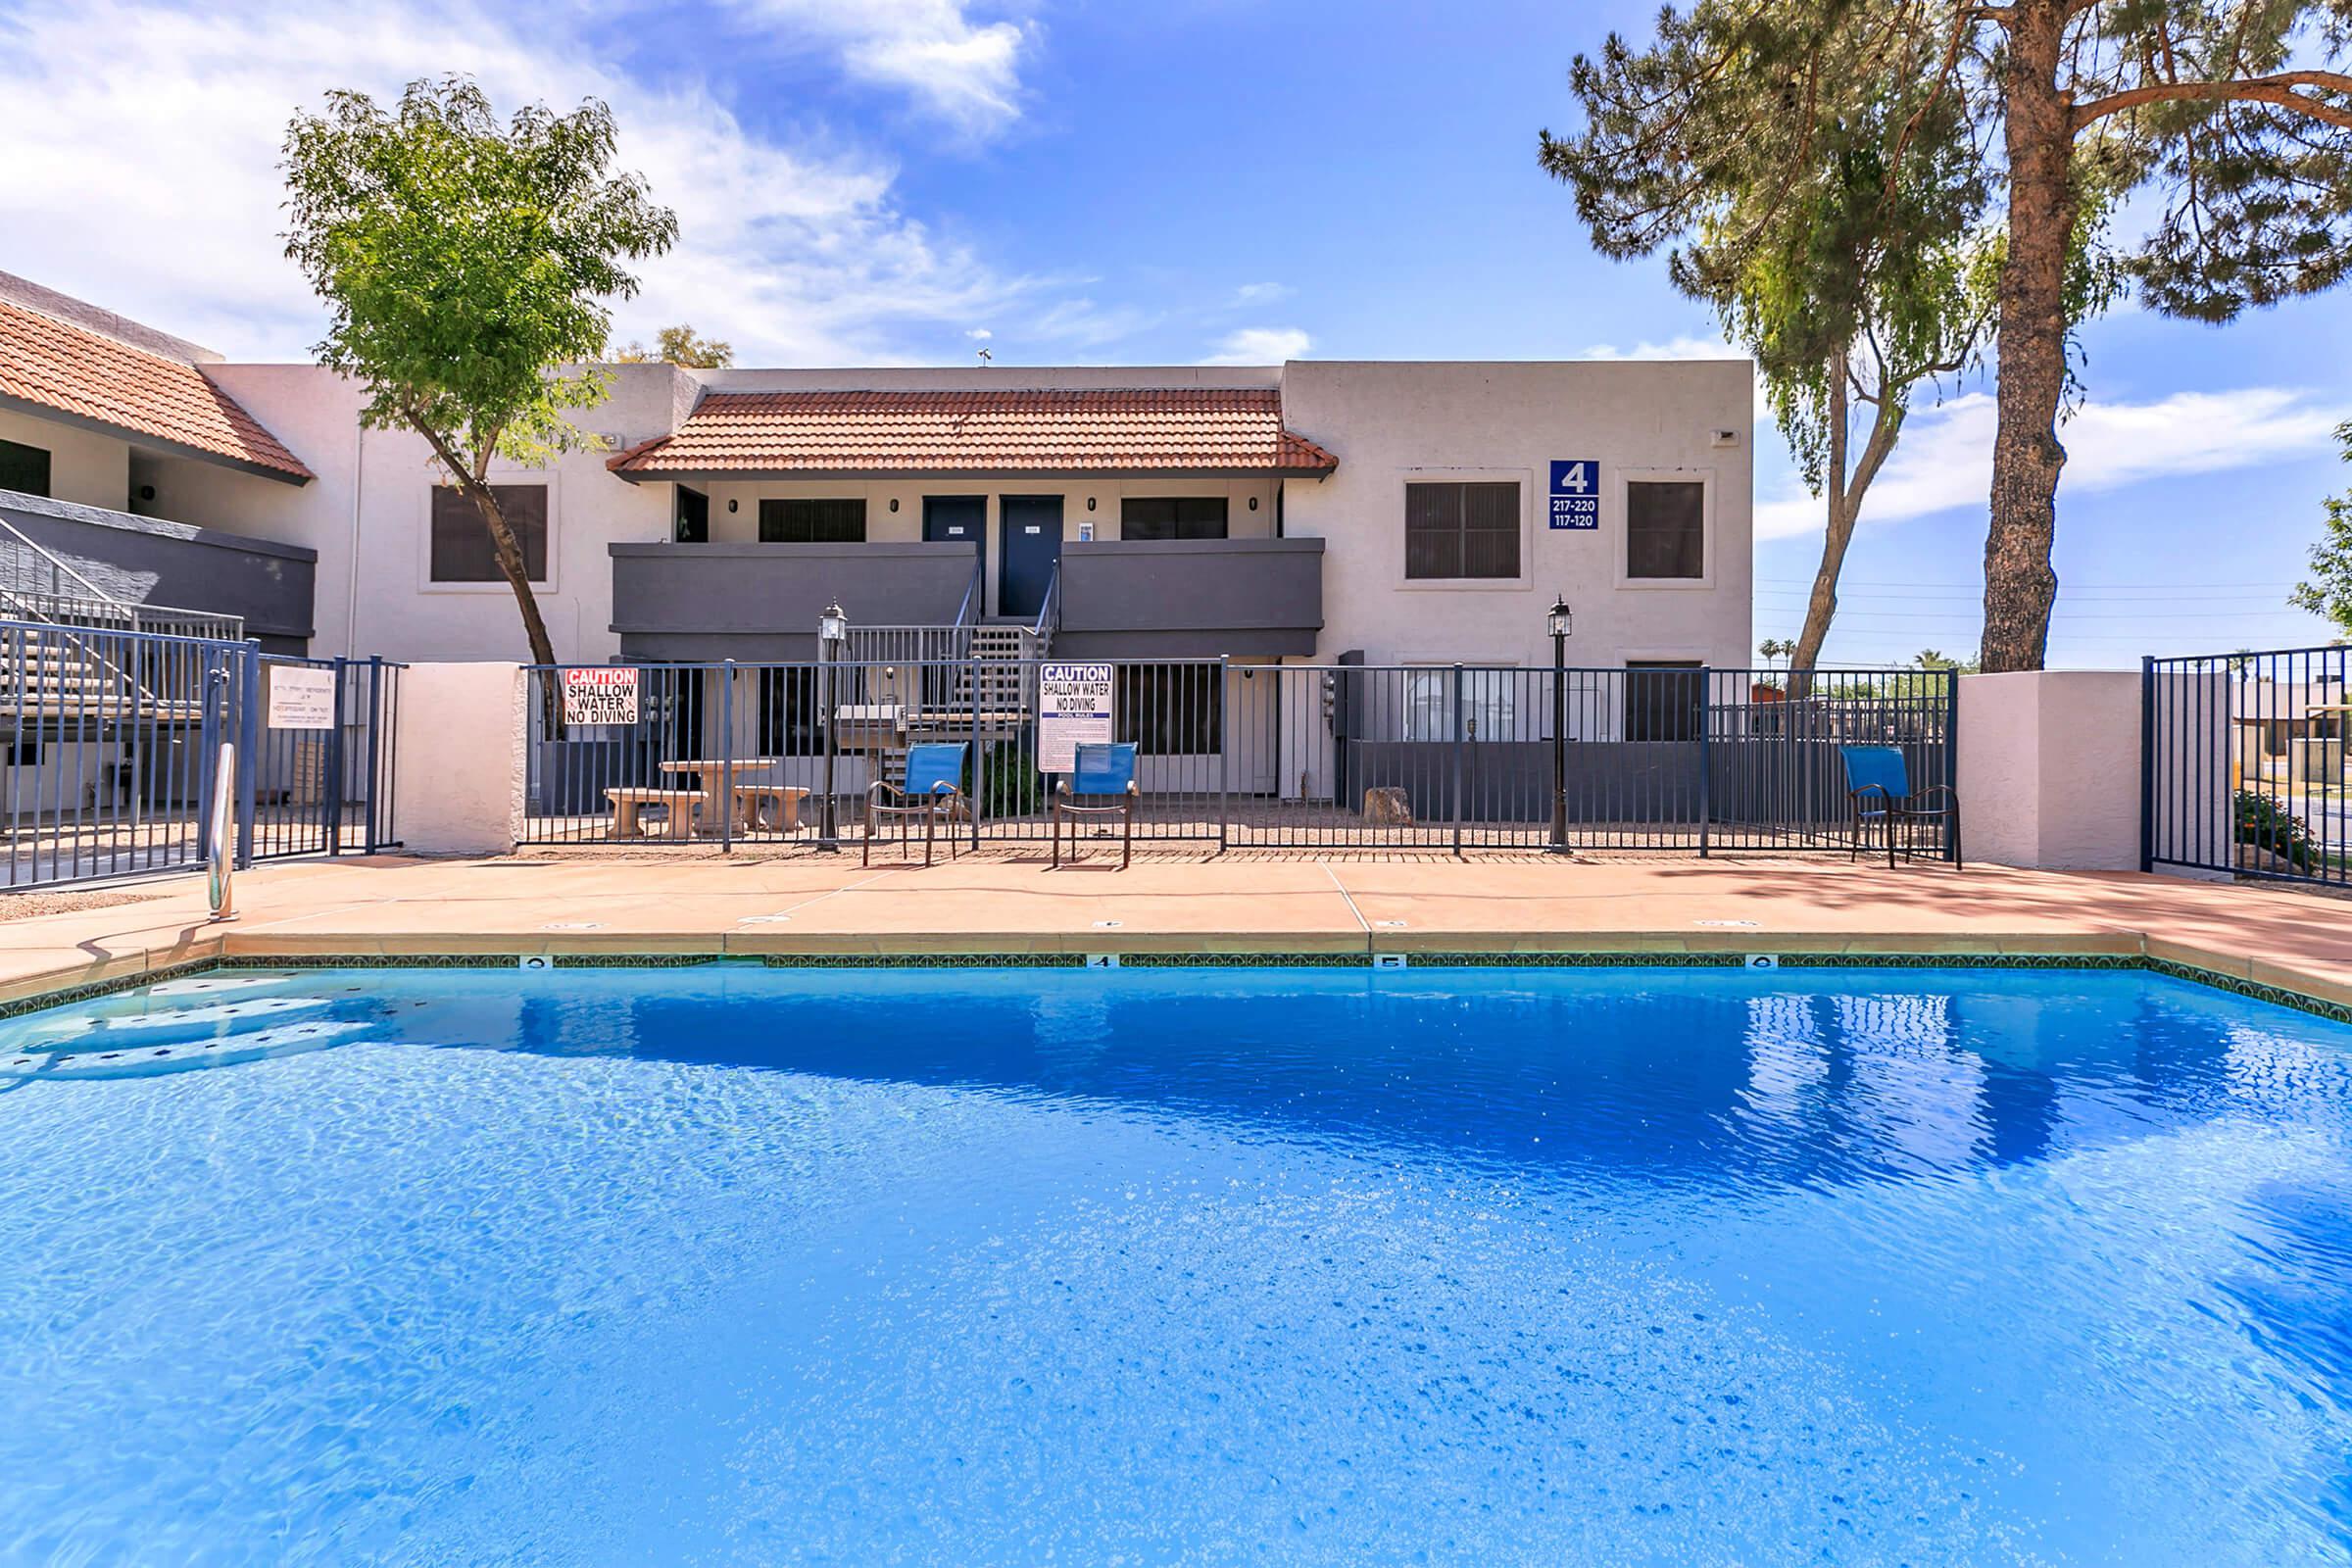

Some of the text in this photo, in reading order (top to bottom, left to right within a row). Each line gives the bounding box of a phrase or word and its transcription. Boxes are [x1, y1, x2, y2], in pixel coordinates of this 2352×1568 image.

[1561, 463, 1588, 493] 4
[1553, 500, 1595, 512] 217-220
[1554, 514, 1593, 526] 117-120
[569, 670, 634, 684] CAUTION
[1045, 666, 1108, 681] CAUTION
[568, 685, 634, 698] SHALLOW
[1044, 683, 1109, 696] SHALLOW WATER
[578, 698, 624, 710] WATER
[1056, 698, 1096, 710] NO DIVING
[567, 710, 635, 722] NO DIVING
